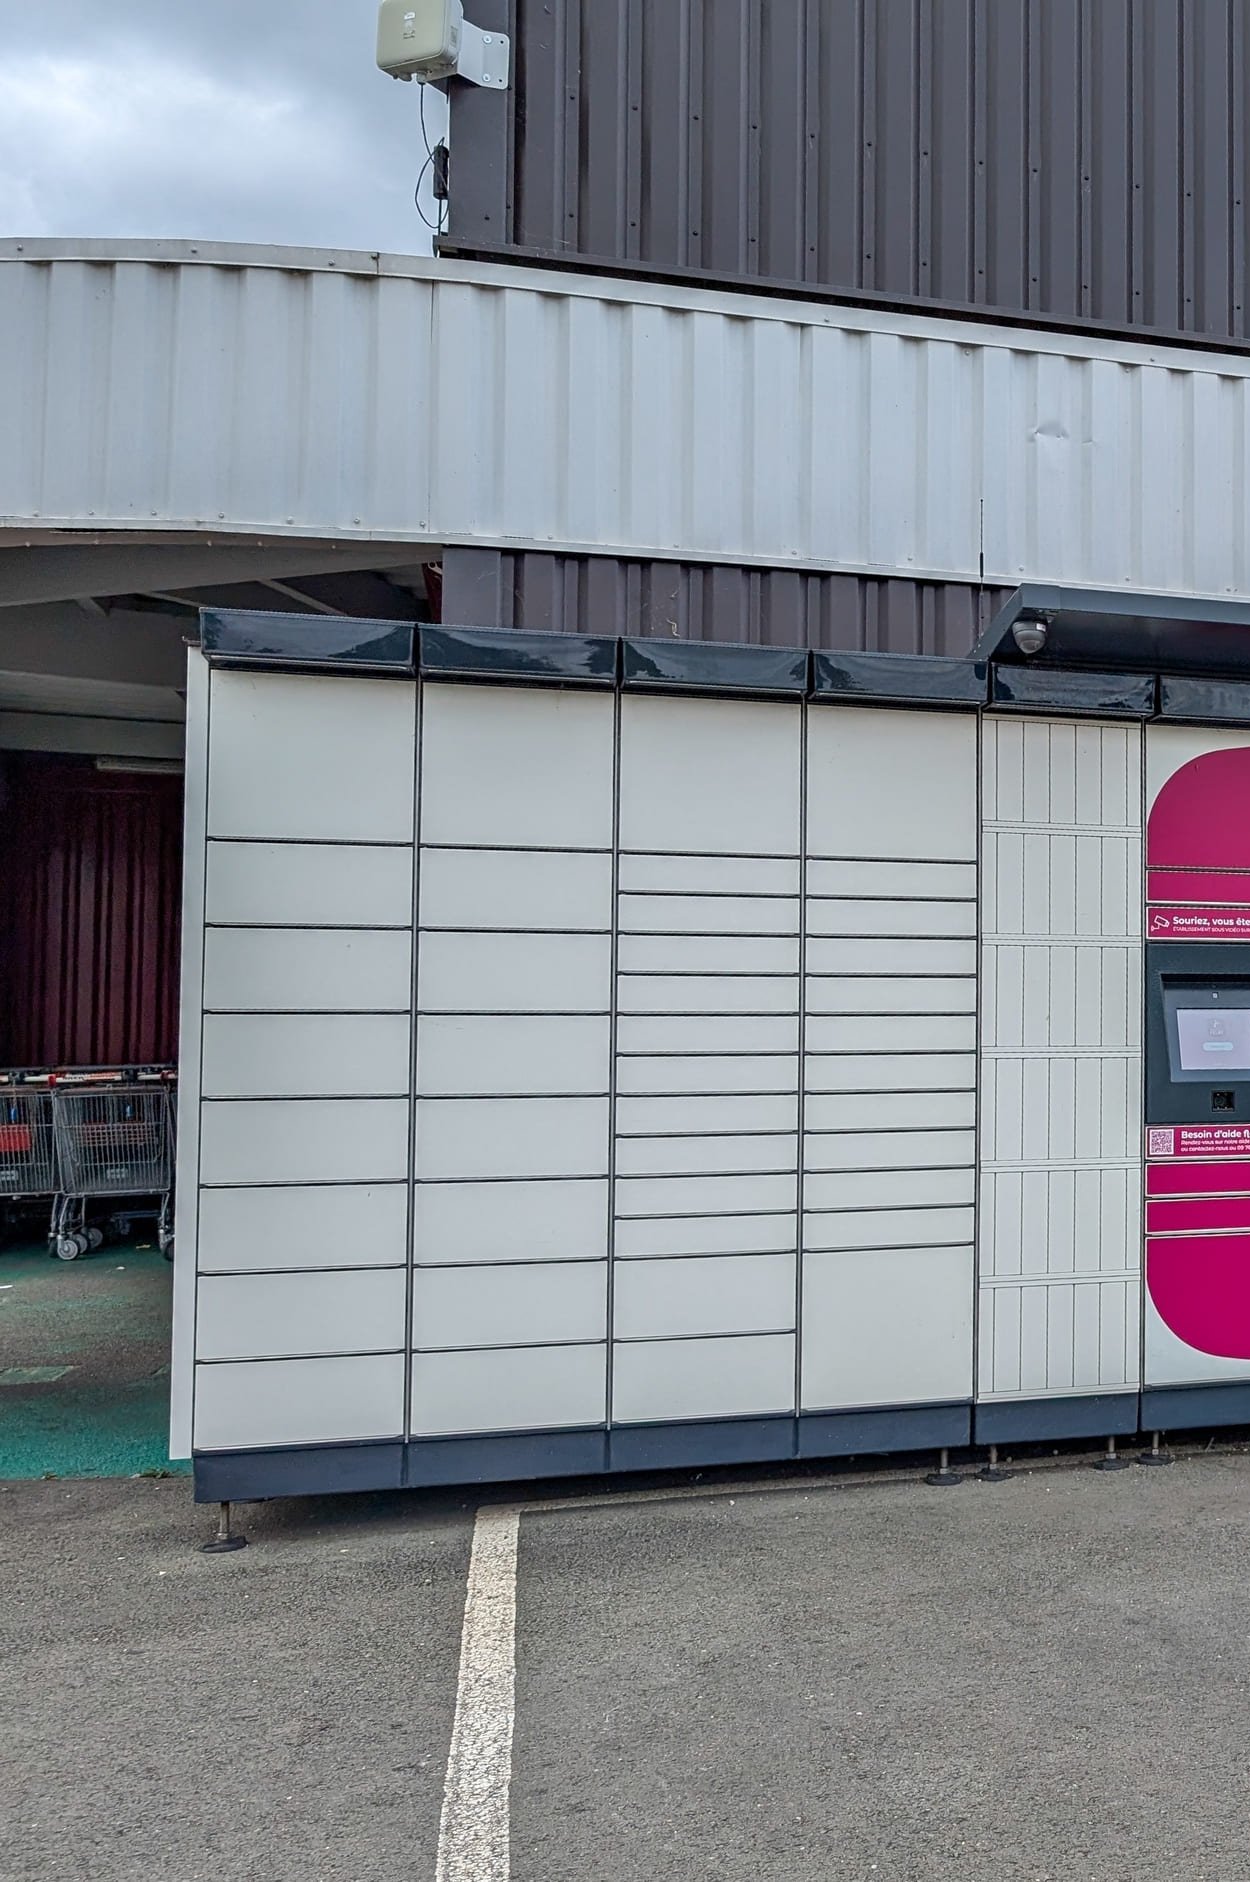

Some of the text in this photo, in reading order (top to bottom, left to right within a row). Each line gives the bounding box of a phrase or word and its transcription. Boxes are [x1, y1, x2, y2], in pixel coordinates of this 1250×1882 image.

[1173, 916, 1210, 927] Souriez,
[1212, 918, 1234, 926] vous
[1181, 1131, 1212, 1139] Besoin
[1214, 1130, 1241, 1138] d'aide
